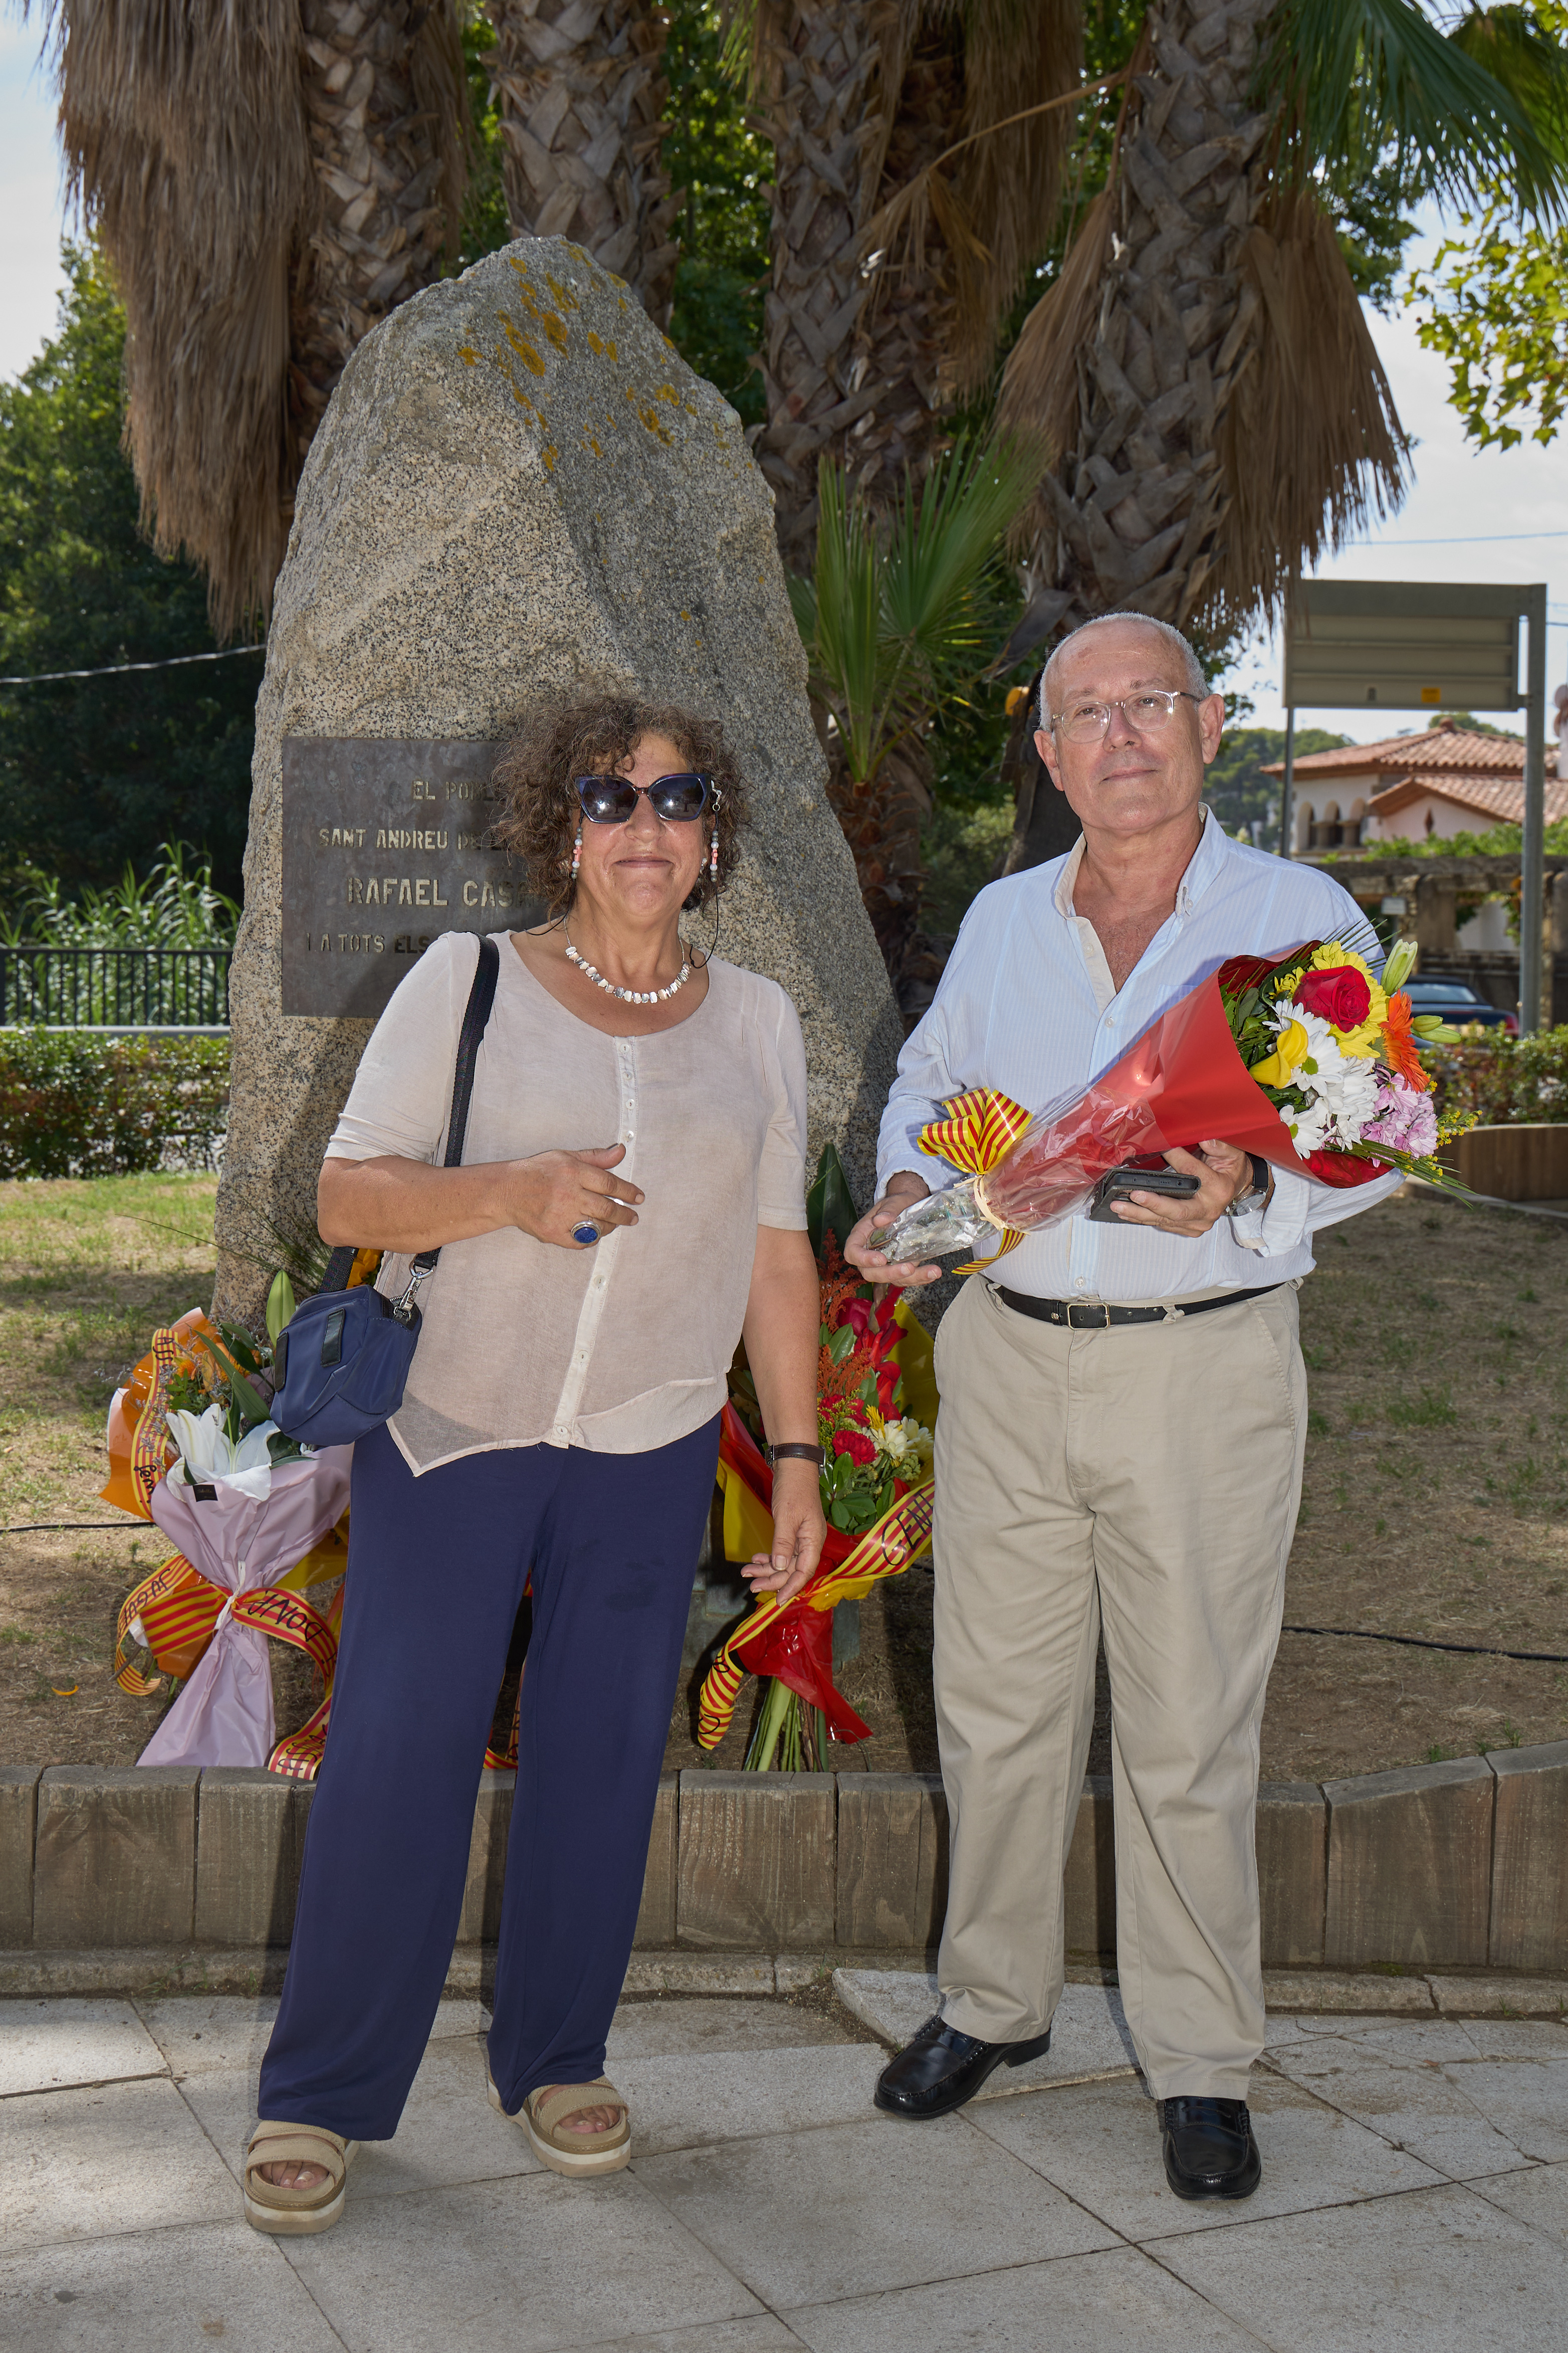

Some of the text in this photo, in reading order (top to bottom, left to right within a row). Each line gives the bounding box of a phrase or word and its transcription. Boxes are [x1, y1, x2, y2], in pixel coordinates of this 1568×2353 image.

[412, 780, 506, 801] EL POBL
[319, 828, 366, 848] SANT
[376, 830, 449, 850] ANDREU
[347, 877, 449, 906] RAFAEL
[320, 932, 331, 952] A
[338, 933, 385, 953] TOTS
[393, 934, 430, 954] ELS
